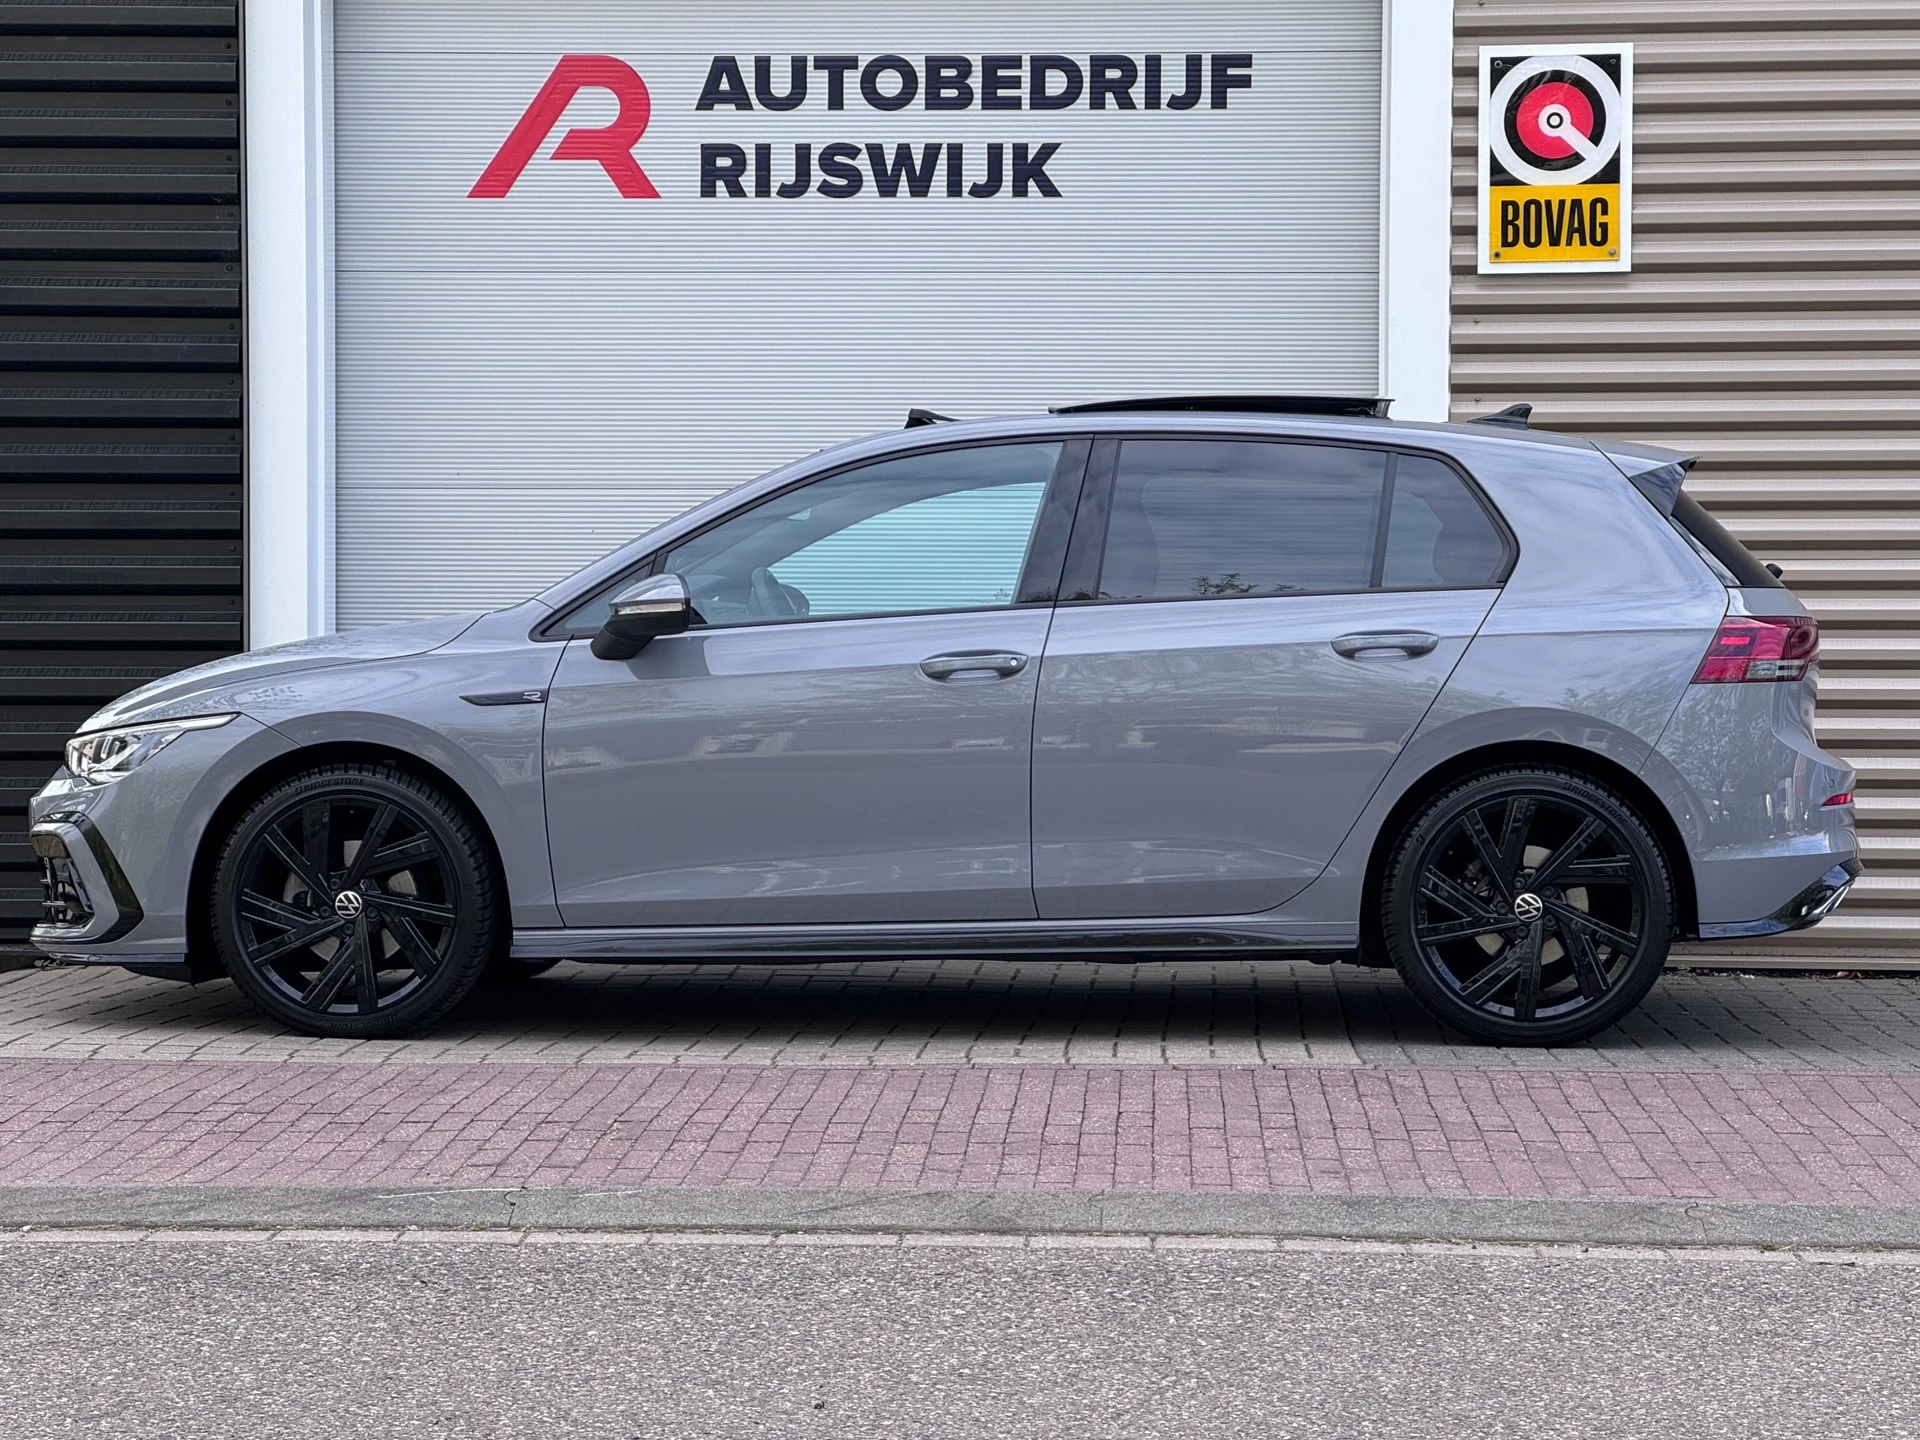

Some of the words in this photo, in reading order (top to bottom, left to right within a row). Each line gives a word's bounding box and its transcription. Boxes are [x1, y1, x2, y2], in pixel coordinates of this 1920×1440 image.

[695, 52, 1252, 111] AUTOBEDRIJF
[700, 142, 1063, 199] RIJSWIJK
[1501, 197, 1609, 249] BOVAG
